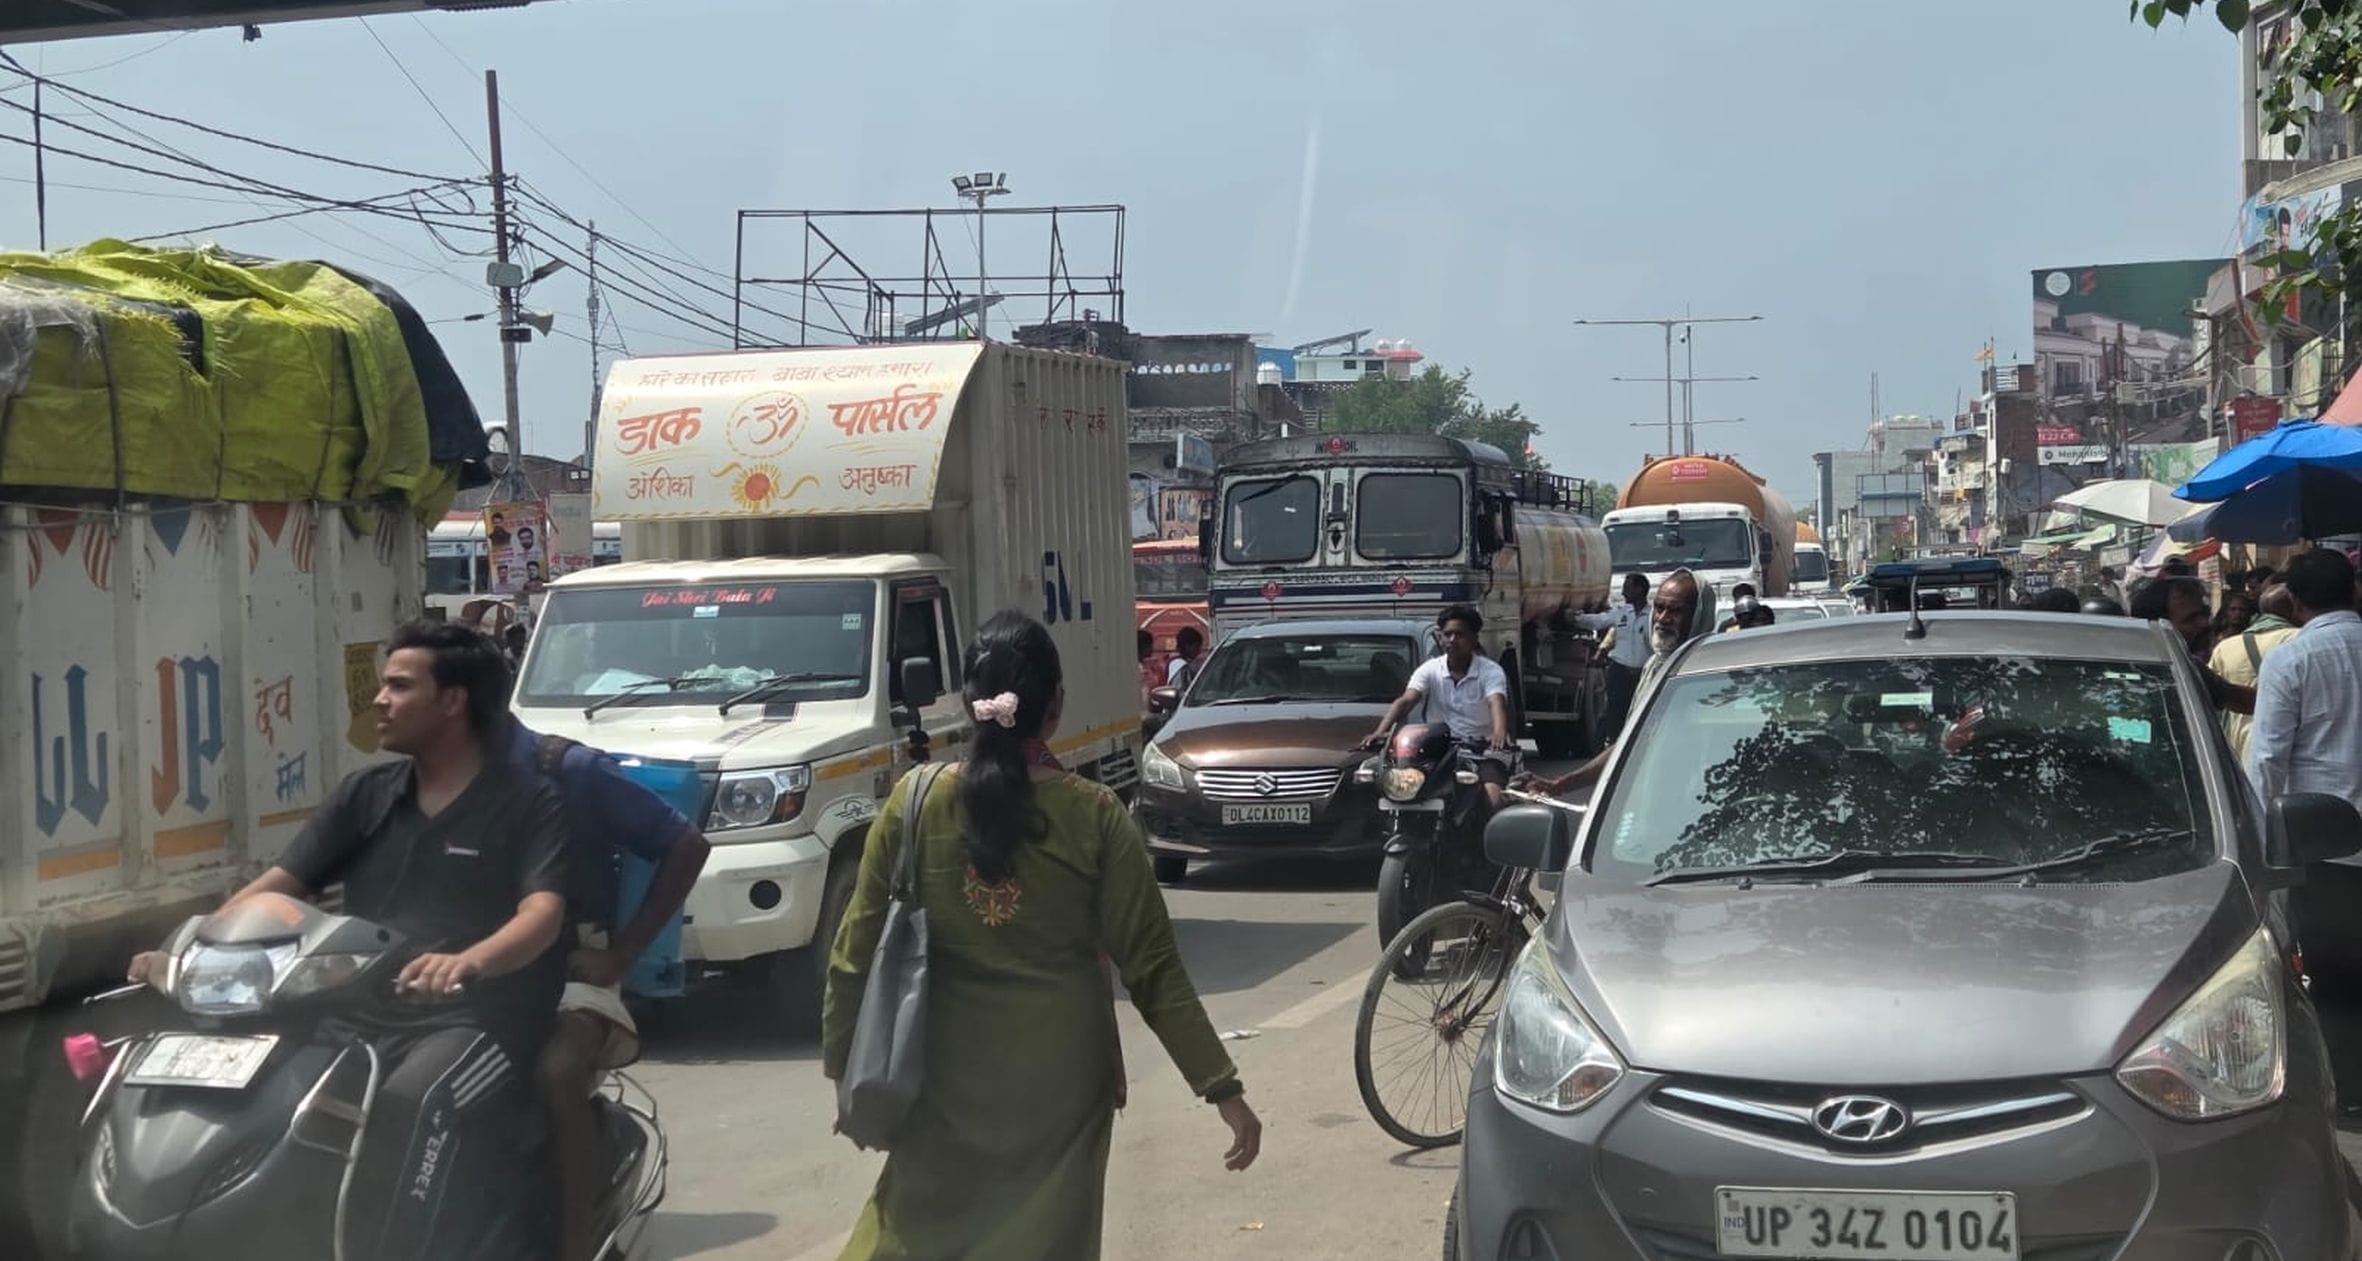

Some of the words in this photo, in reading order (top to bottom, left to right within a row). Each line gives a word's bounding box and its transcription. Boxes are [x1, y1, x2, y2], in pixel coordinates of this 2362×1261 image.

[616, 406, 702, 455] डाक
[826, 383, 944, 436] पार्सल
[838, 463, 918, 495] अनुष्का
[1229, 806, 1309, 823] DL4CAX0112
[1743, 1206, 1792, 1248] UP
[1809, 1207, 1887, 1250] 34Z
[1904, 1209, 2011, 1253] 0104
